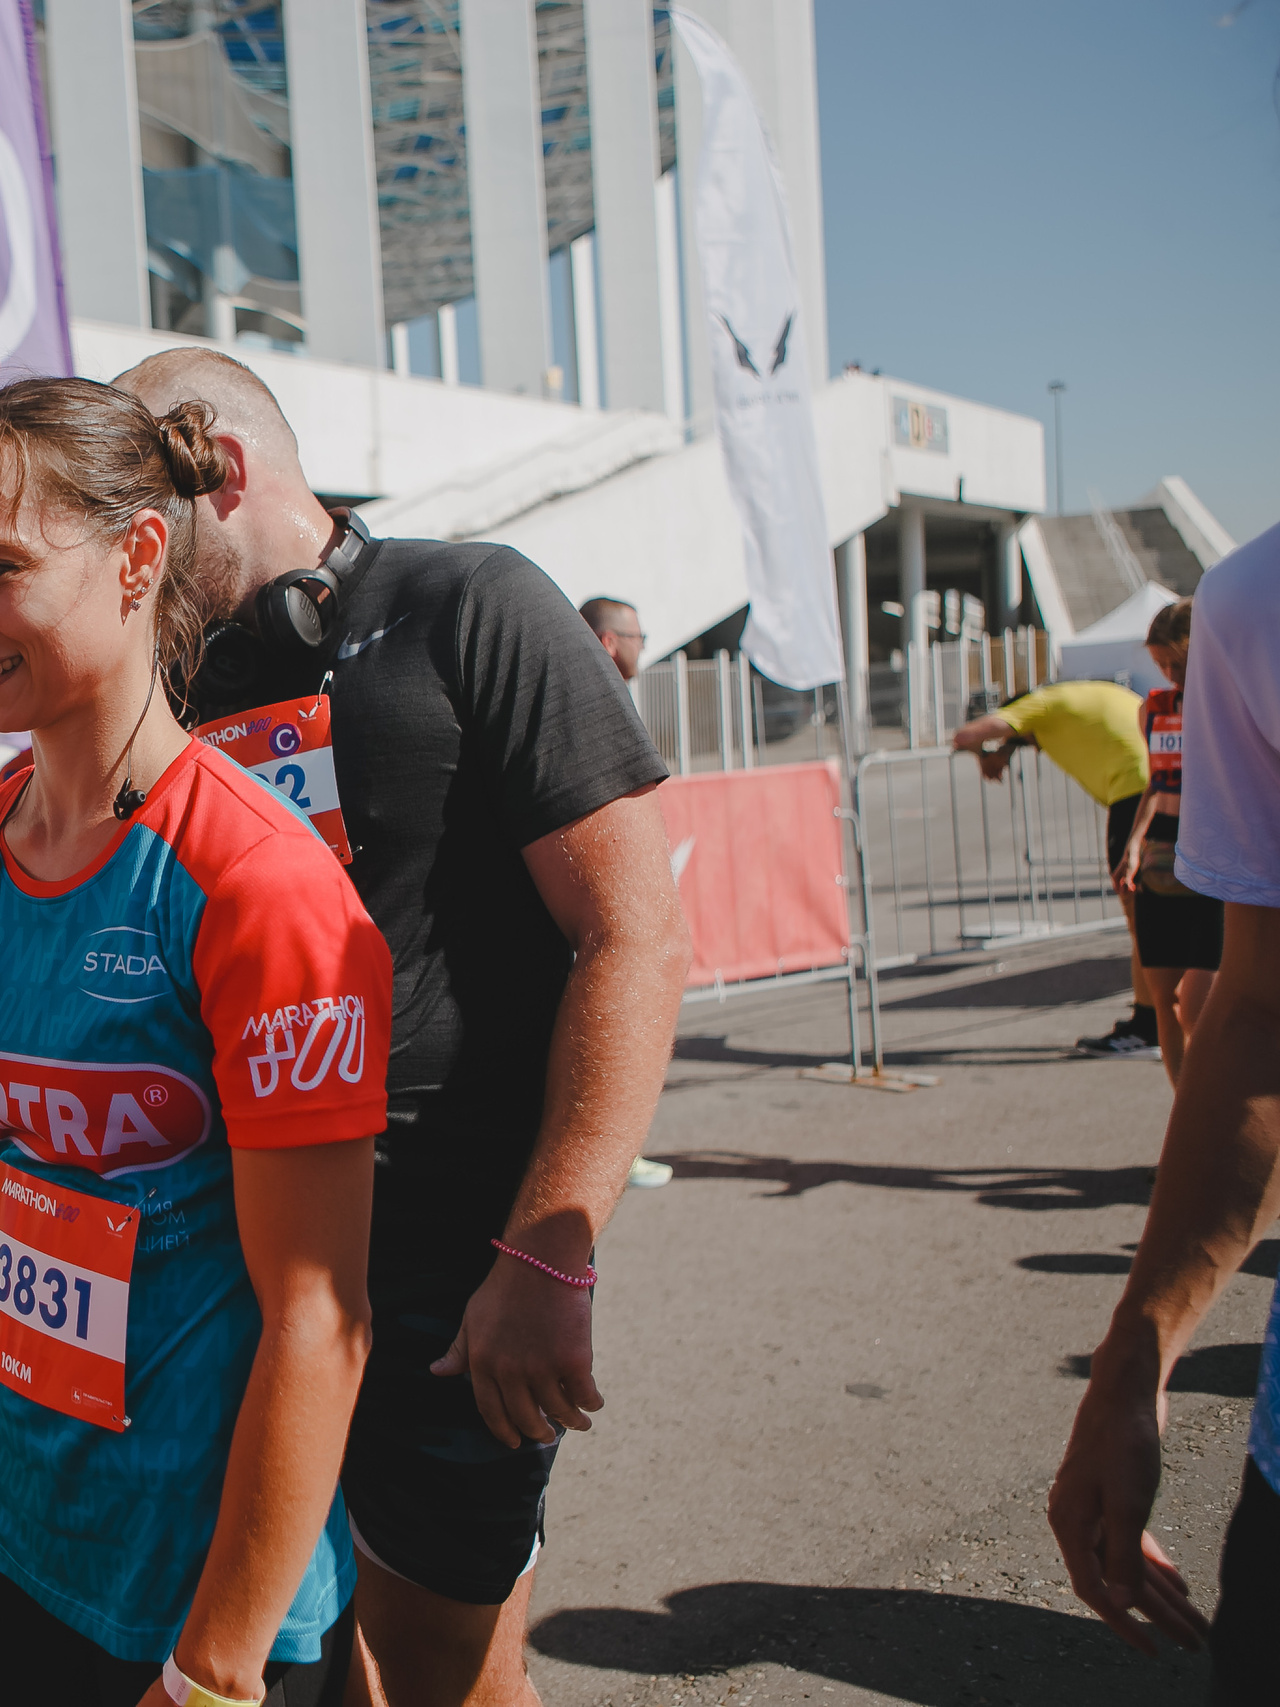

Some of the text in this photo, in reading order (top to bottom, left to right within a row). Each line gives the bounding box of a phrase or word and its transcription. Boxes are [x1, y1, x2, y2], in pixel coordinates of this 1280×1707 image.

[275, 728, 296, 751] C
[253, 764, 311, 809] 2
[83, 951, 168, 976] STADA
[241, 994, 365, 1041] MARATHON
[1, 1177, 57, 1217] MARATHON
